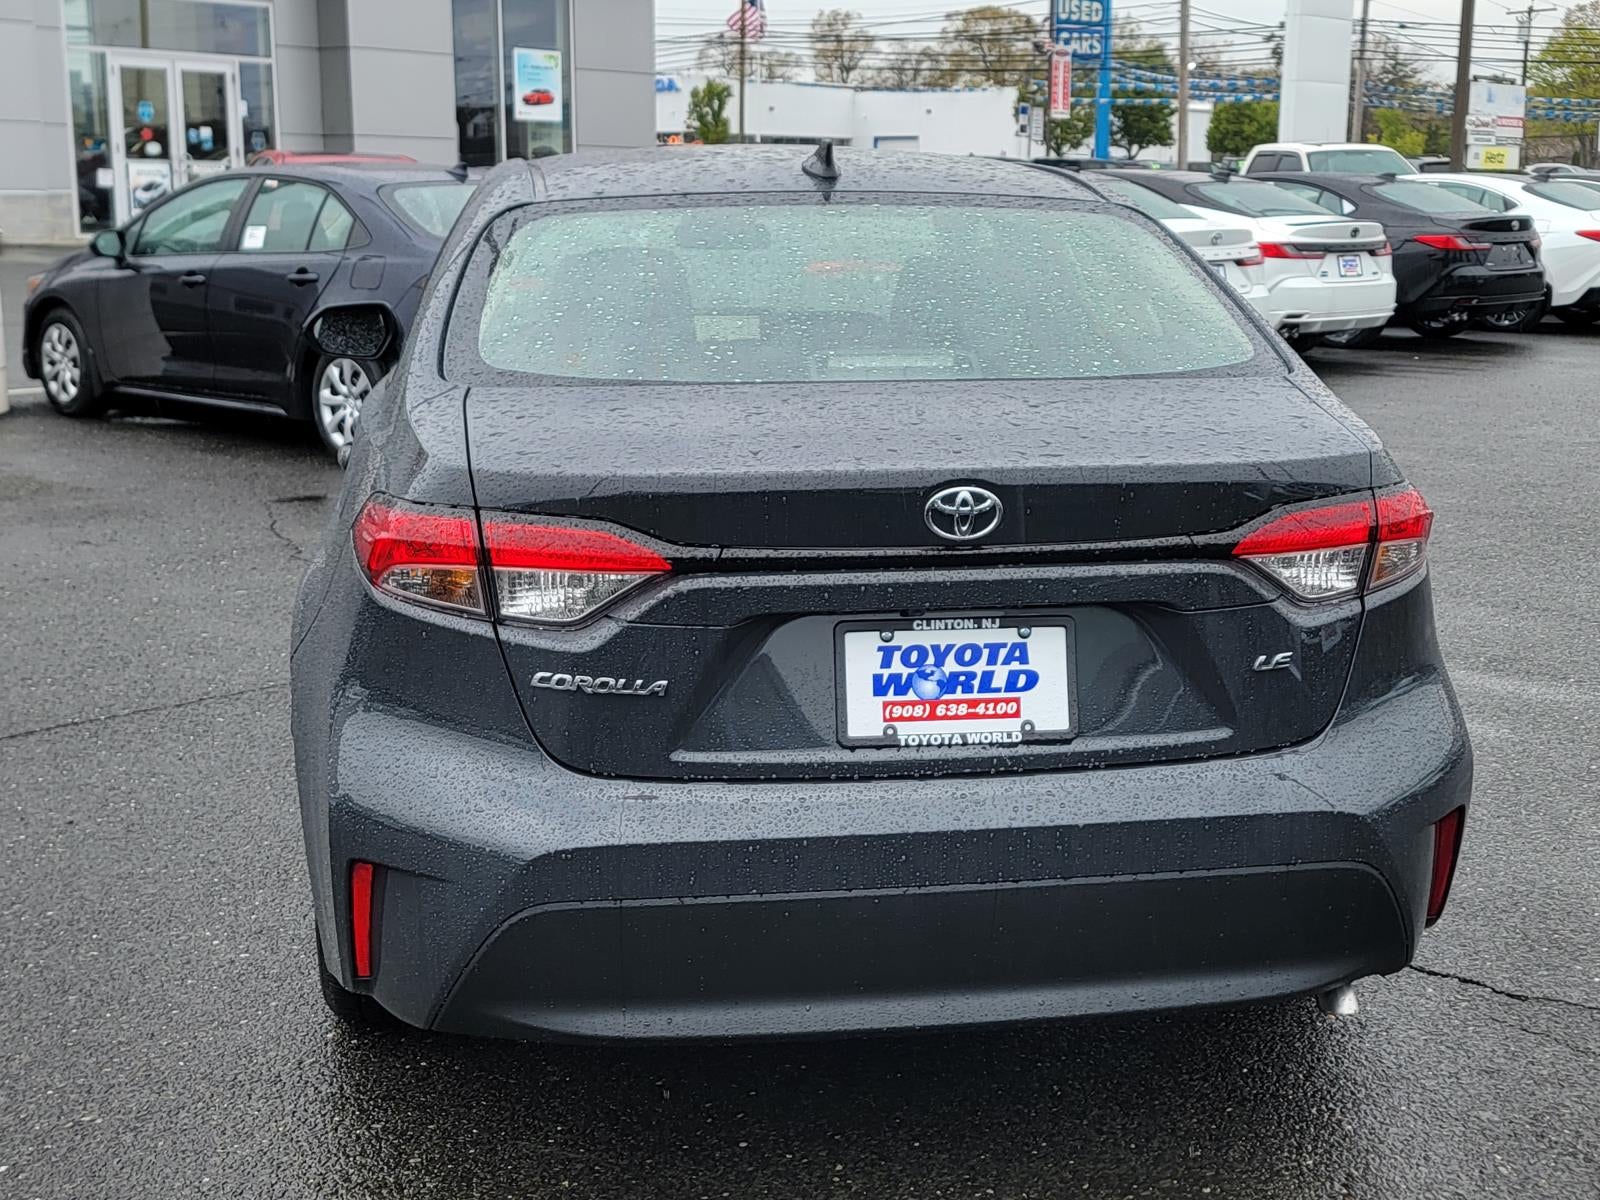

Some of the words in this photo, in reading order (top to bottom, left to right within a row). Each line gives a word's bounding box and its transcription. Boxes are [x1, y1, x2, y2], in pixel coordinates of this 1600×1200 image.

[1058, 0, 1104, 22] USED
[1058, 31, 1102, 55] CARS
[982, 618, 1000, 629] NJ
[877, 642, 1030, 669] TOYOTA
[1254, 652, 1294, 671] LE
[530, 672, 668, 696] COROLLA
[885, 704, 931, 718] (908)
[936, 702, 1018, 717] 638-4100
[898, 734, 963, 747] TOYOTA
[967, 732, 1022, 744] WORLD
